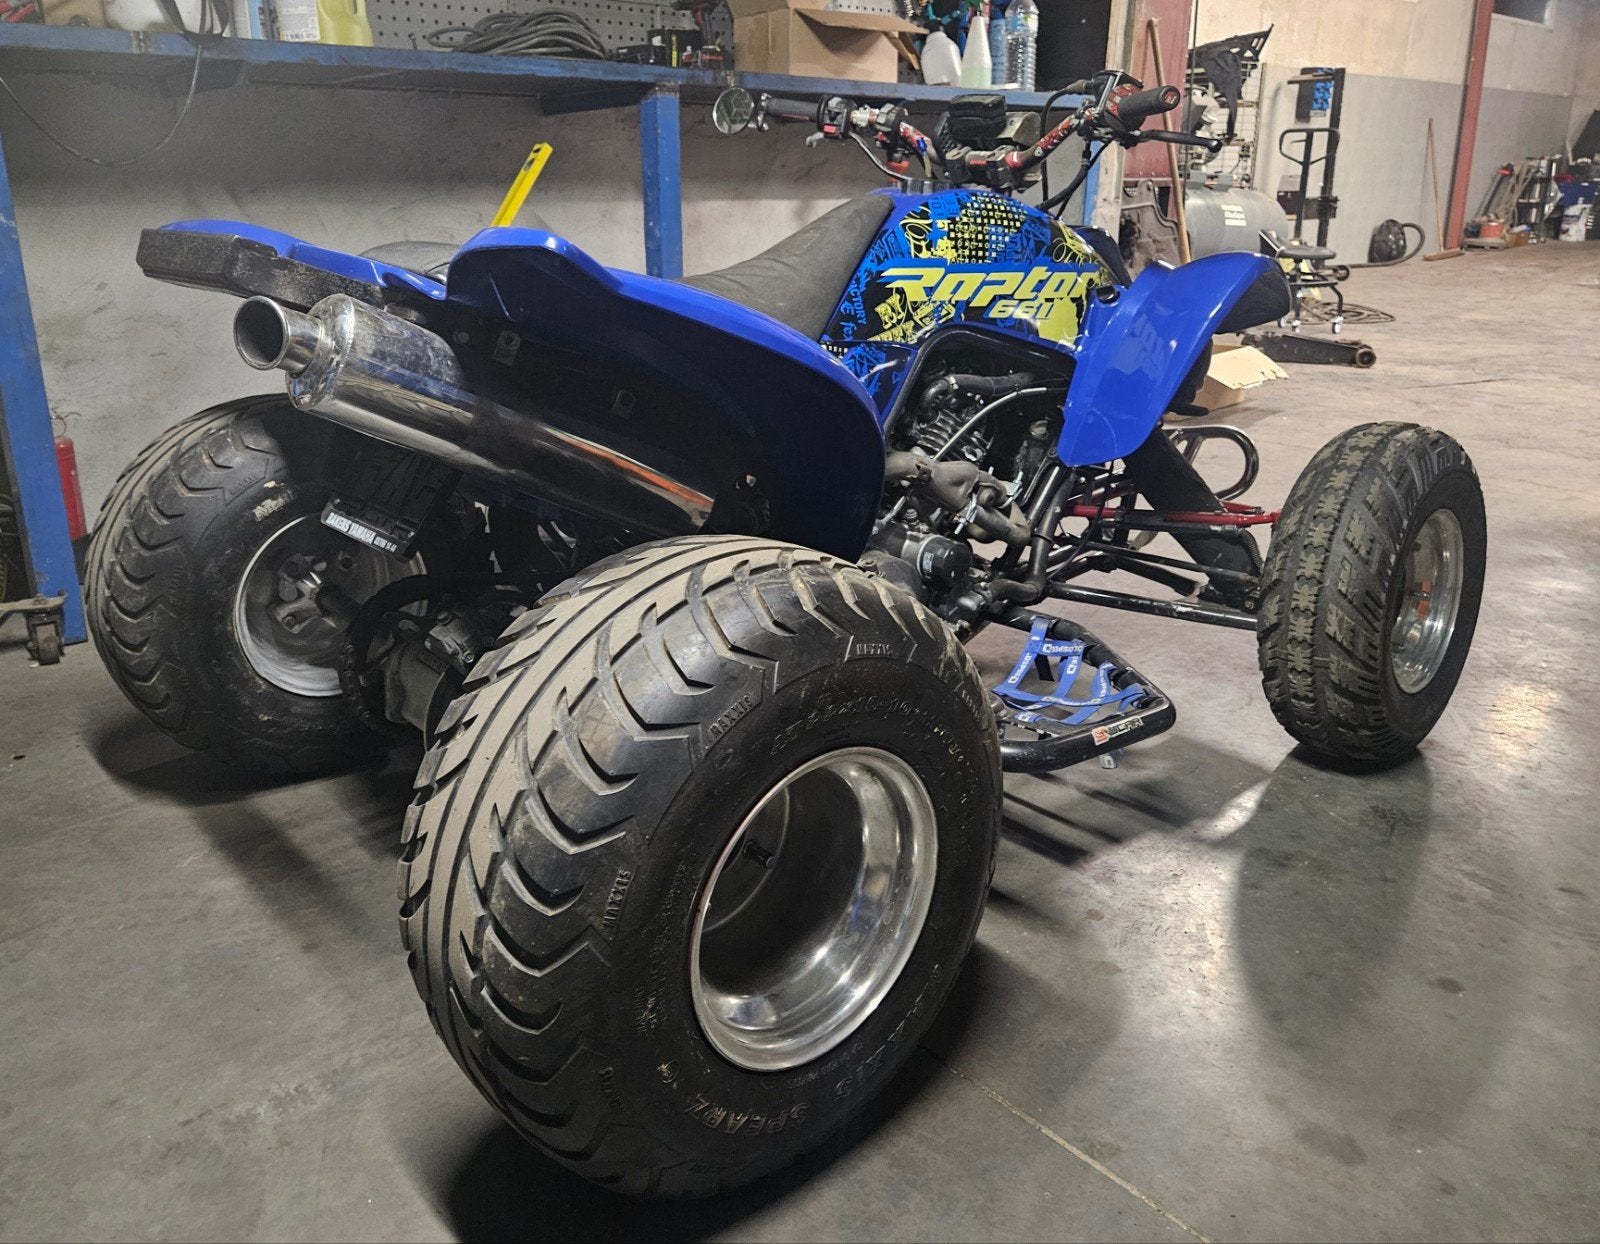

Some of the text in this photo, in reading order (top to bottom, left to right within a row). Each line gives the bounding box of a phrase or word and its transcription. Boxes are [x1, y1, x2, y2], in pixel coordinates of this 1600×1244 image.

[881, 266, 1099, 307] Raptor
[348, 522, 376, 544] YAMAHA
[709, 694, 755, 740] MAXXIS
[602, 869, 632, 929] MAXXIS
[685, 1093, 809, 1135] SPEARZ
